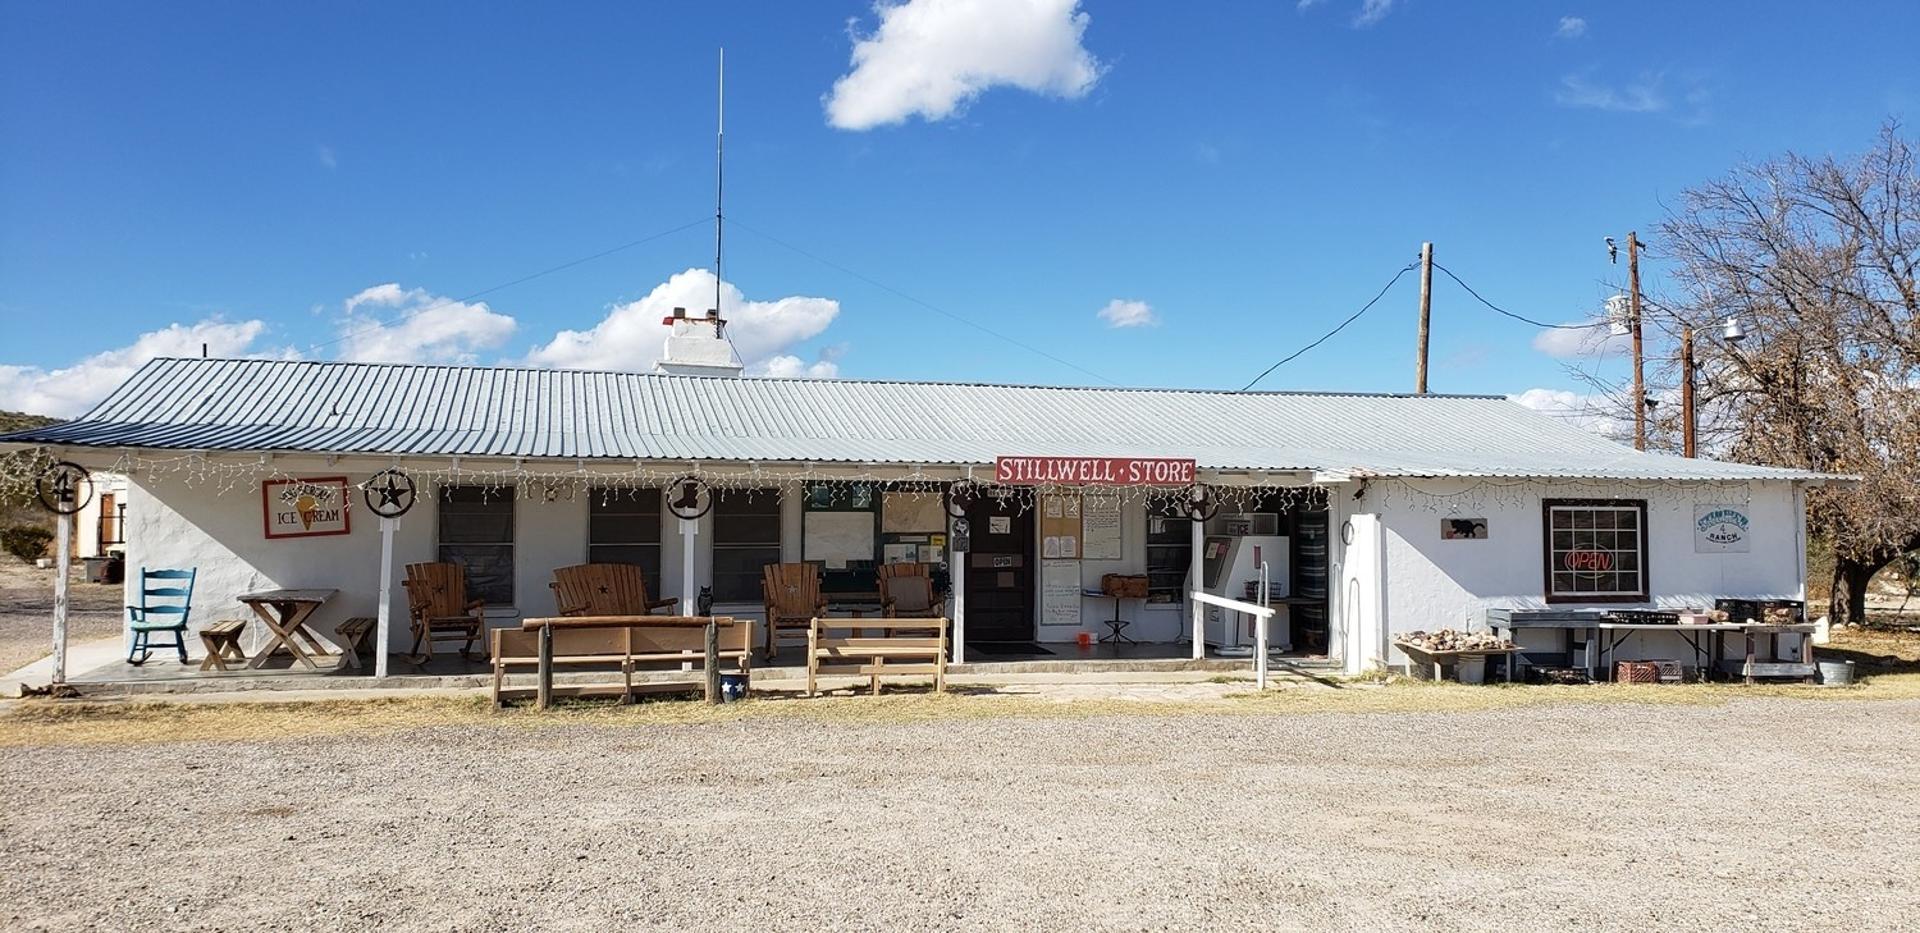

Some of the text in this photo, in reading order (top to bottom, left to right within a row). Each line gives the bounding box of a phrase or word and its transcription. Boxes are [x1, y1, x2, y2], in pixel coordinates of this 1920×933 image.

[999, 458, 1193, 482] STILLWELL STORE
[277, 509, 339, 525] ICE CREAM
[1709, 533, 1738, 541] RANCH
[1567, 551, 1610, 570] OPEN
